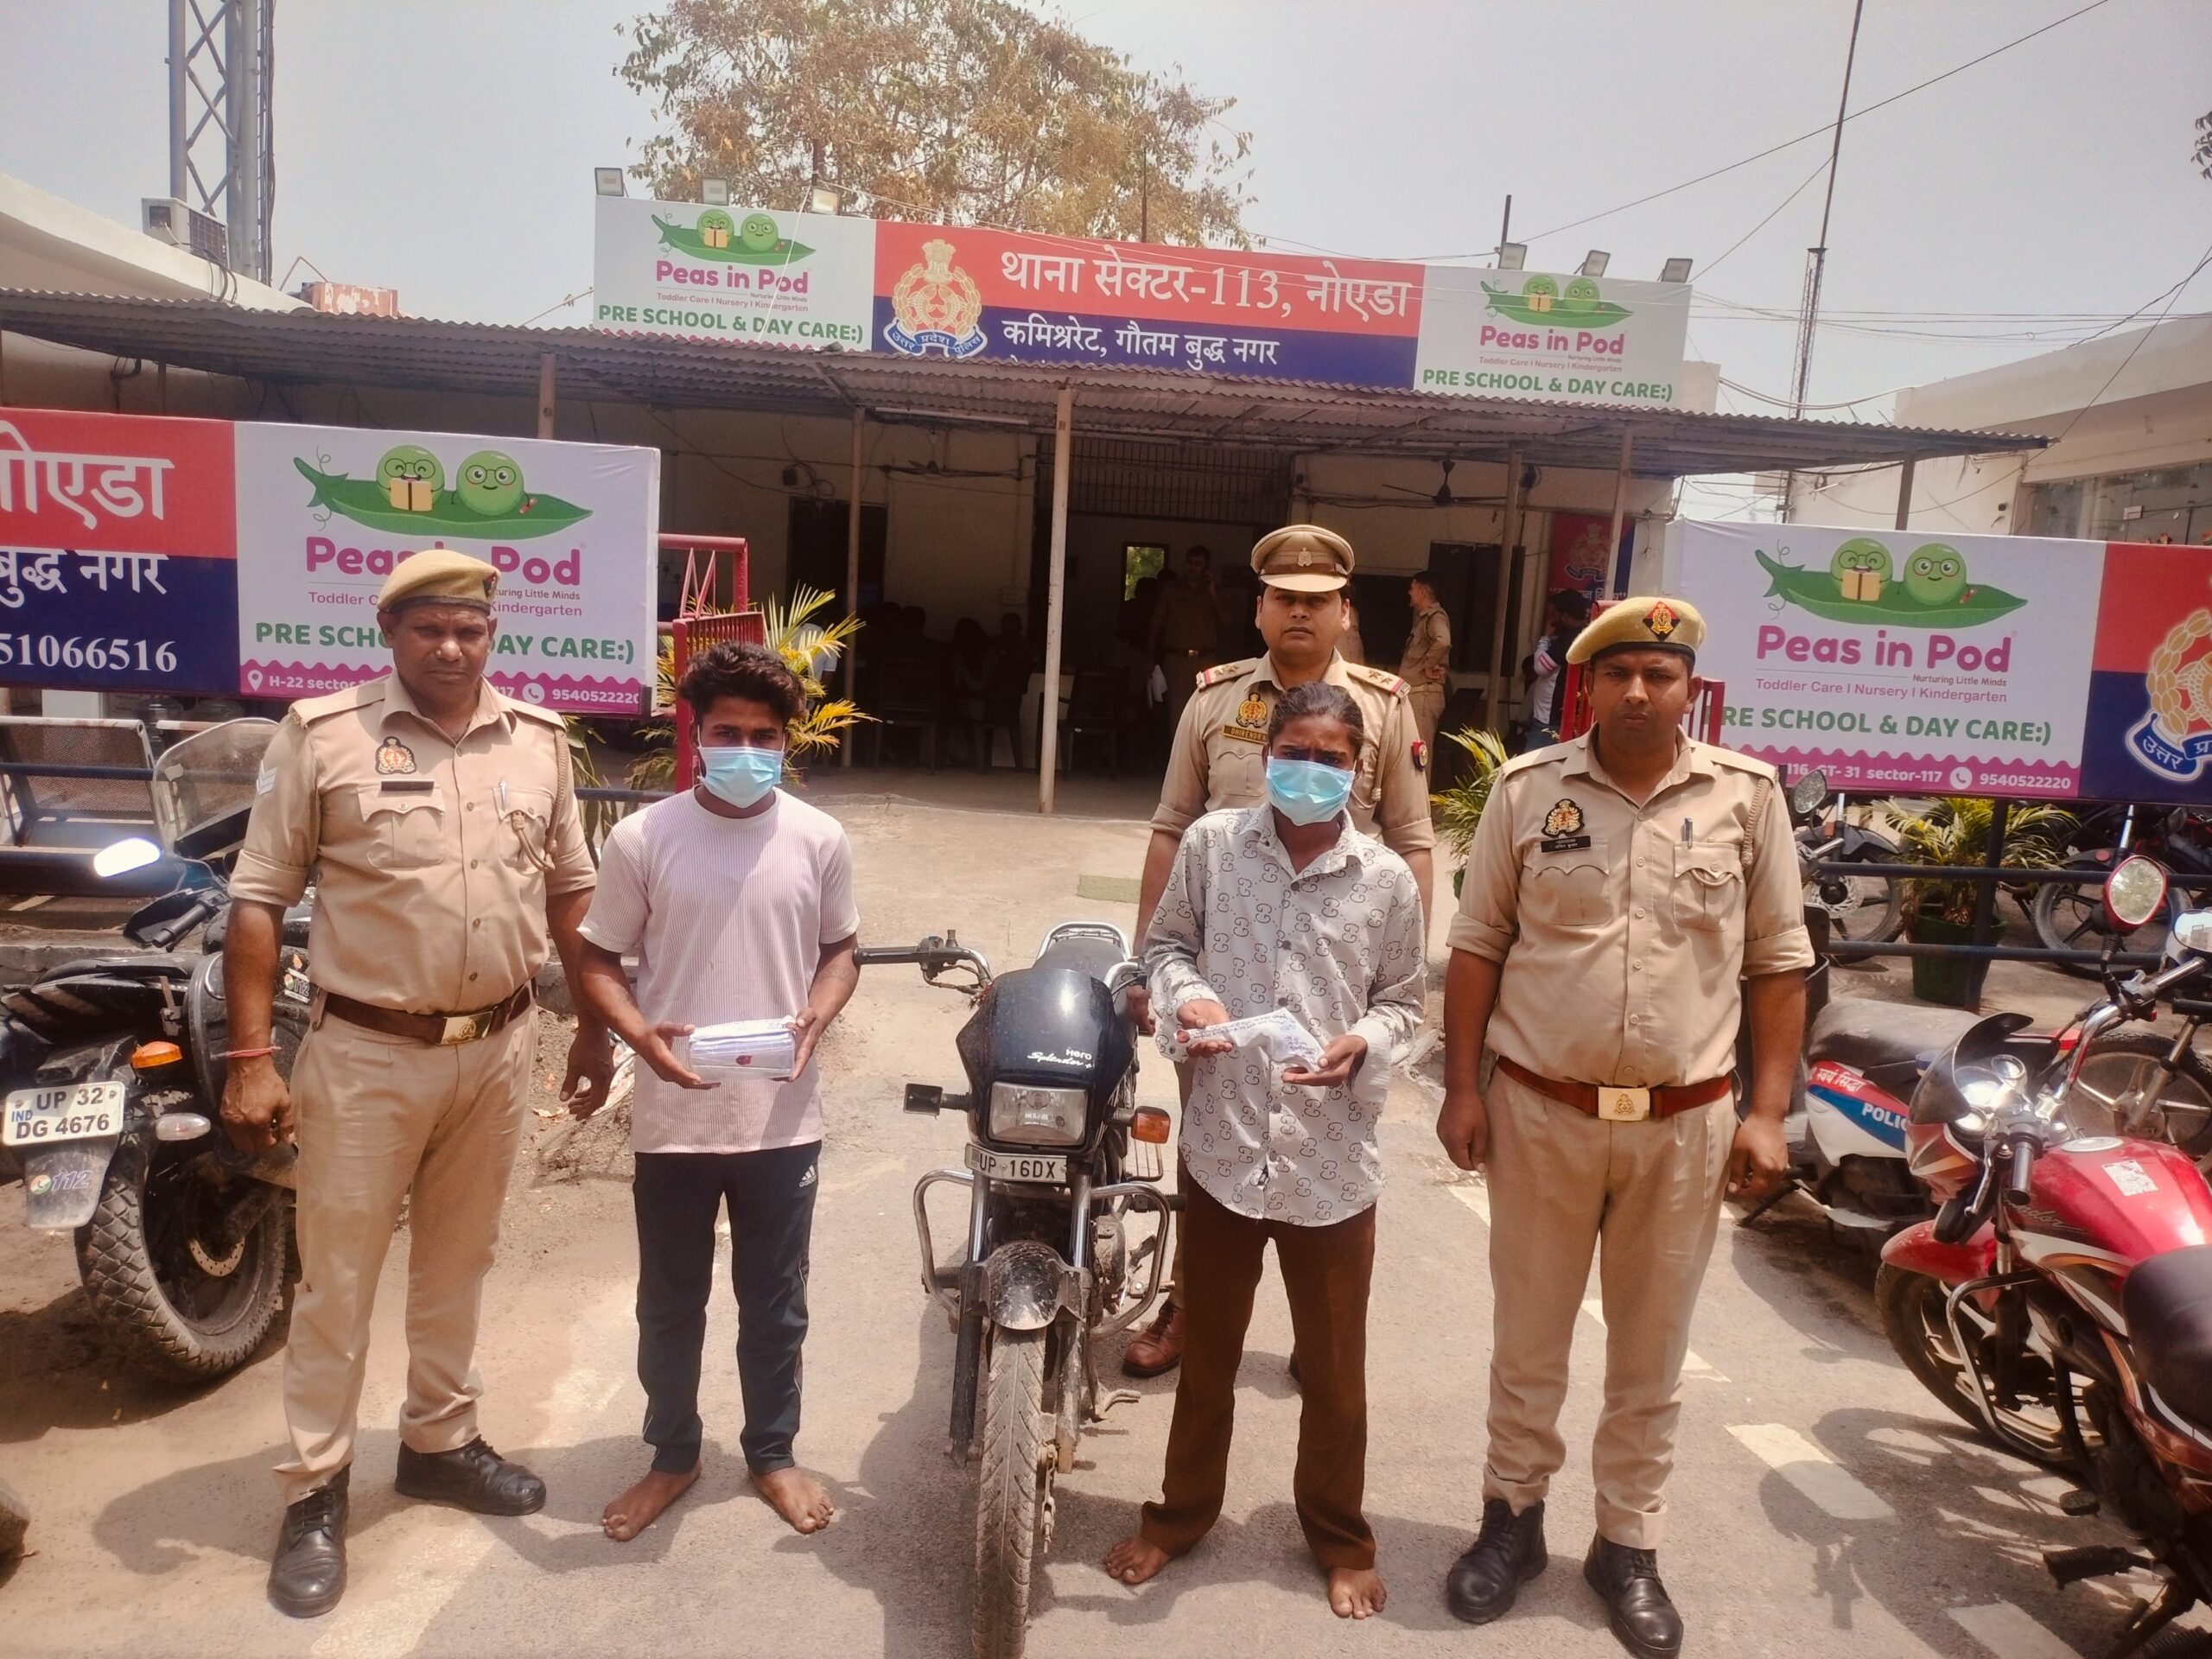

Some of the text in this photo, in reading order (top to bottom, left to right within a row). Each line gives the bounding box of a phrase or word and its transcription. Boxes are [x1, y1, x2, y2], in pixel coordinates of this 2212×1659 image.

[657, 260, 808, 294] Peas in Pod
[1001, 244, 1413, 322] थाना सेक्टर-113, नोएडा
[657, 292, 688, 302] Toddler
[690, 295, 709, 303] Care
[715, 297, 748, 308] Nursery
[754, 301, 809, 312] Kindergarten
[599, 305, 864, 344] PRE SCHOOL & DAY CARE:)
[1115, 320, 1179, 358] गौतम
[1183, 334, 1229, 372] बुद्ध
[1231, 338, 1281, 365] नगर
[1479, 325, 1624, 354] Peas in Pod
[1479, 356, 1508, 365] Toddler
[1535, 360, 1565, 370] Nursery
[1571, 363, 1622, 373] Kindergarten
[1422, 369, 1673, 403] PRE SCHOOL & DAY CARE:)
[73, 550, 170, 594] नगर
[492, 546, 580, 586] Pod
[308, 591, 365, 605] Toddler
[524, 588, 550, 599] Little
[551, 591, 581, 601] Minds
[256, 622, 311, 645] PRE
[490, 634, 533, 656] AY
[540, 636, 634, 664] CARE:)
[1757, 625, 2012, 673] Peas in Pod
[269, 676, 303, 688] H-22
[1756, 677, 1807, 691] Toddler
[1810, 680, 1843, 694] Care
[1855, 683, 1908, 700] Nursery
[1919, 687, 2007, 703] Kindergarten
[1912, 674, 2006, 687] Nurturing Little Minds
[1761, 708, 1872, 734] SCHOOL
[1878, 715, 1898, 734] &
[1905, 715, 1960, 738] DAY
[1965, 719, 2051, 747] CARE:)
[2143, 735, 2184, 770] उत्तर
[1845, 766, 1860, 779] 31
[1866, 768, 1942, 783] sector-117
[1980, 774, 2071, 790] 9540522220
[1027, 1052, 1084, 1066] Splendor
[1065, 1047, 1092, 1060] Hero
[36, 1087, 104, 1111] UP 32
[10, 1109, 34, 1122] IND
[16, 1114, 110, 1140] DG 4676
[979, 1153, 1056, 1179] UP 16DX
[51, 1170, 92, 1192] 112
